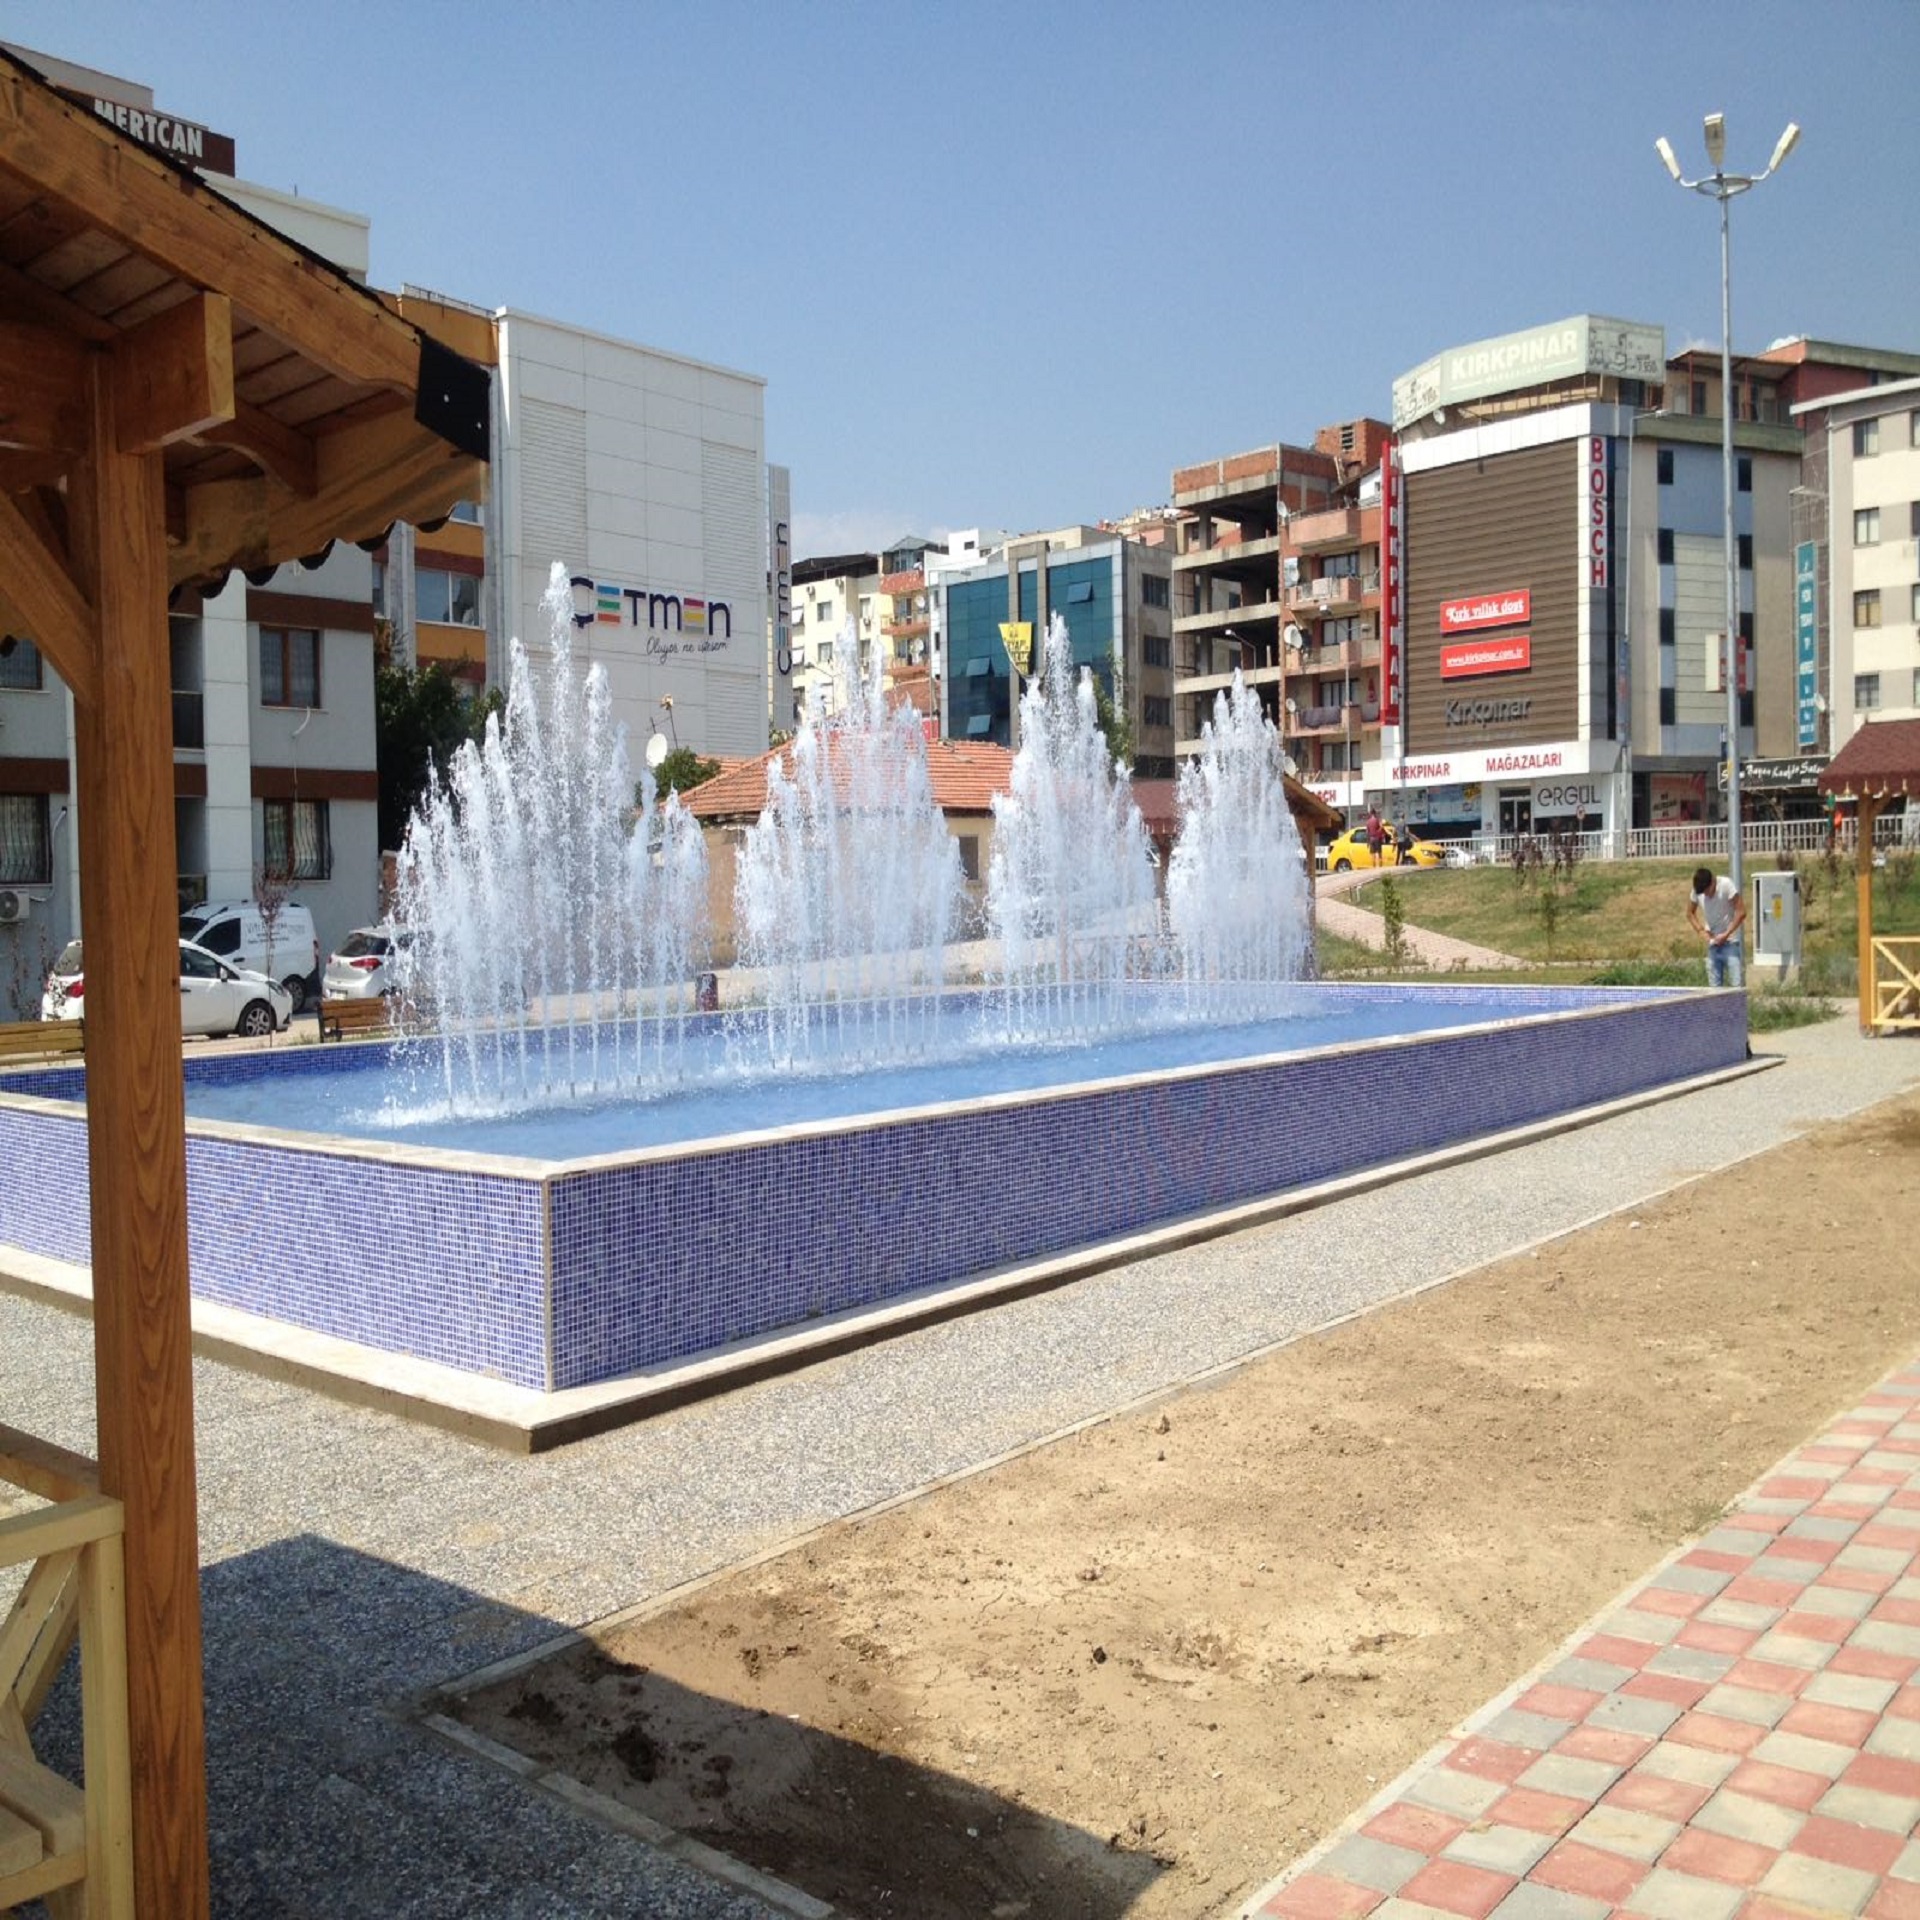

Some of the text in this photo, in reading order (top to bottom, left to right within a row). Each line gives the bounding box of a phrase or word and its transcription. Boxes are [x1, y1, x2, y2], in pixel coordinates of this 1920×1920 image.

[94, 99, 202, 158] MERTCAN
[1451, 330, 1578, 381] KIRKPINAR
[1591, 437, 1604, 586] BOSCH
[1392, 752, 1562, 780] KIRKPINAR MAĞAZALARI
